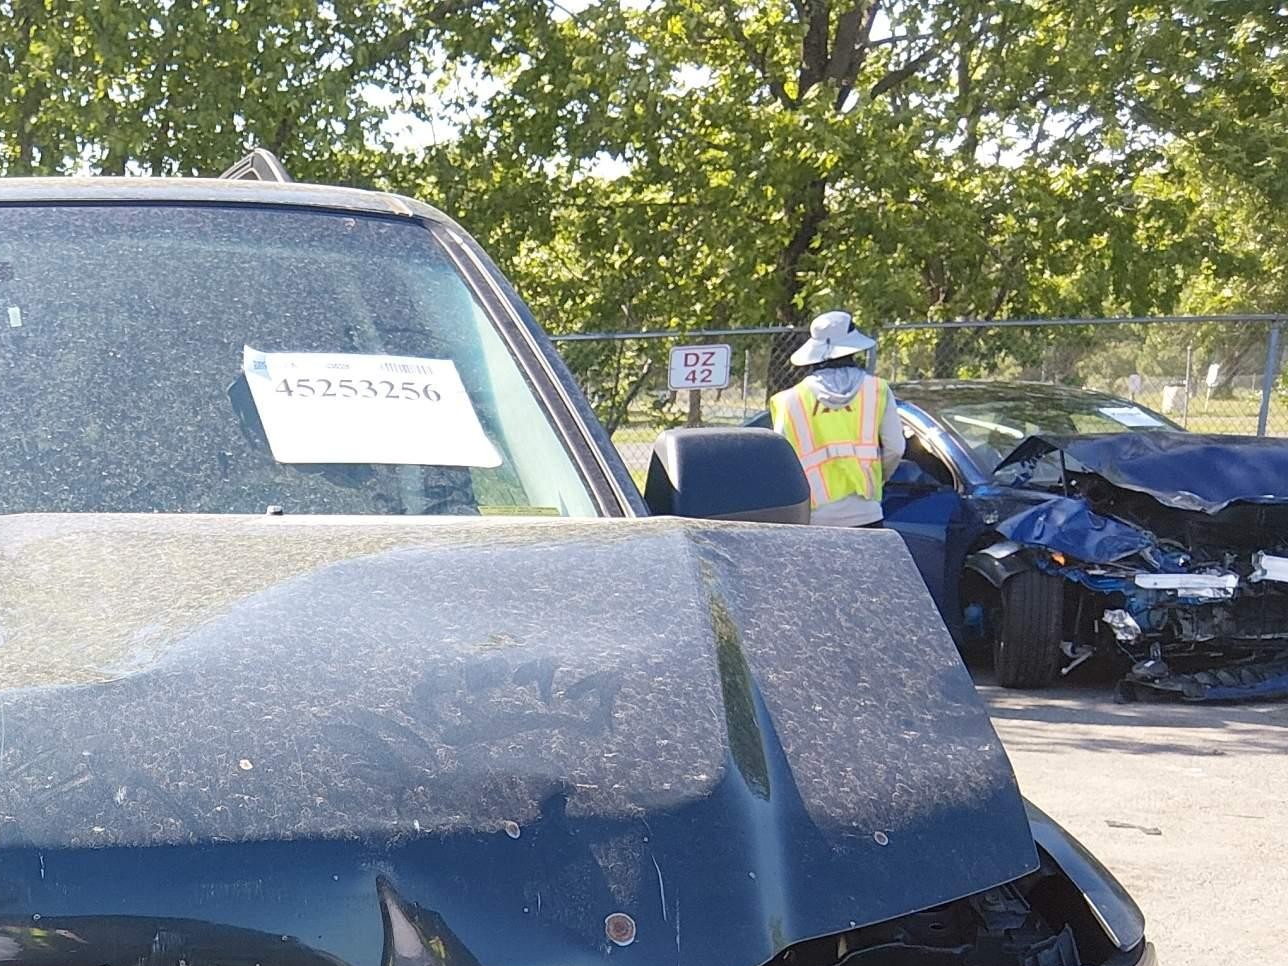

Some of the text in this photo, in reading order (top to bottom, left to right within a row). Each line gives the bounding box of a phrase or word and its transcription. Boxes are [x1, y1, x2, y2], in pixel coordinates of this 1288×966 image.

[684, 351, 716, 367] DZ
[684, 368, 713, 384] 42
[275, 378, 441, 402] 45253256
